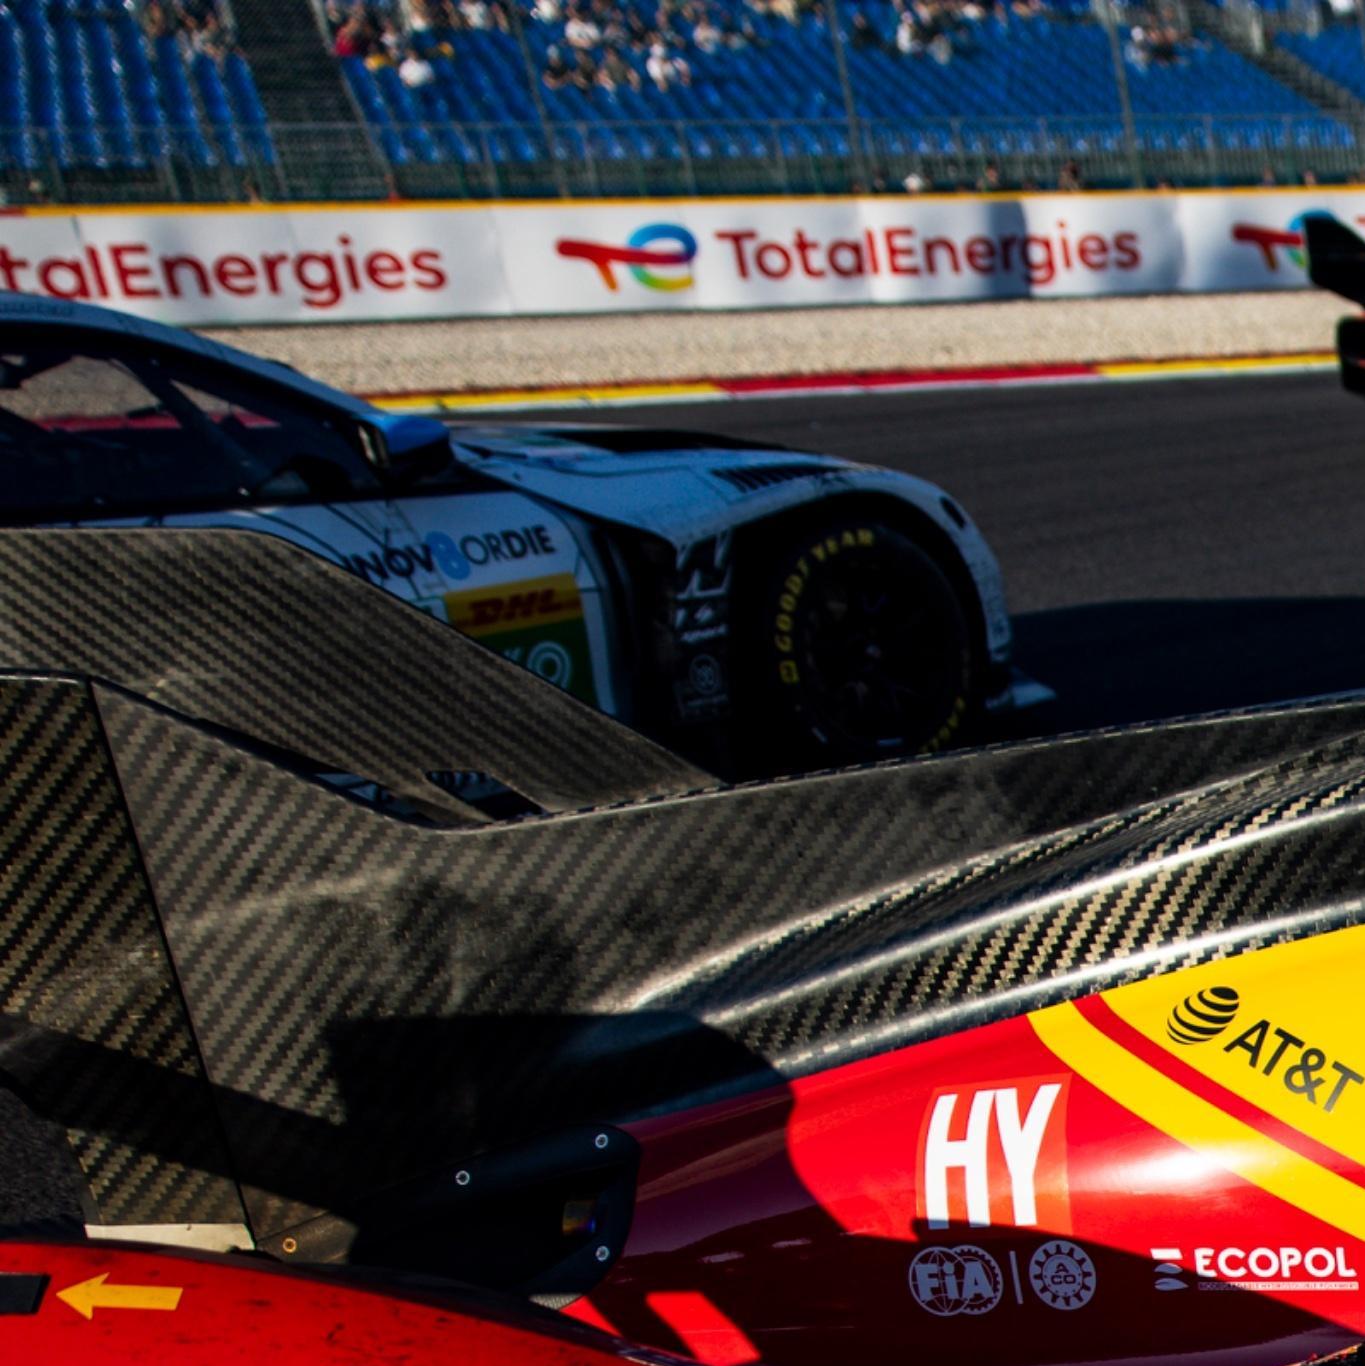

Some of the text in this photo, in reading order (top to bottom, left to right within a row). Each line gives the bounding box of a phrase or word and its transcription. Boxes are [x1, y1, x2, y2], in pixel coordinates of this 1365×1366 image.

[0, 233, 446, 308] talEnergies
[715, 220, 1141, 286] TotalEnergies
[1223, 1018, 1364, 1114] AT&T
[924, 1083, 1063, 1231] HY
[1193, 1246, 1358, 1279] ECOPOL
